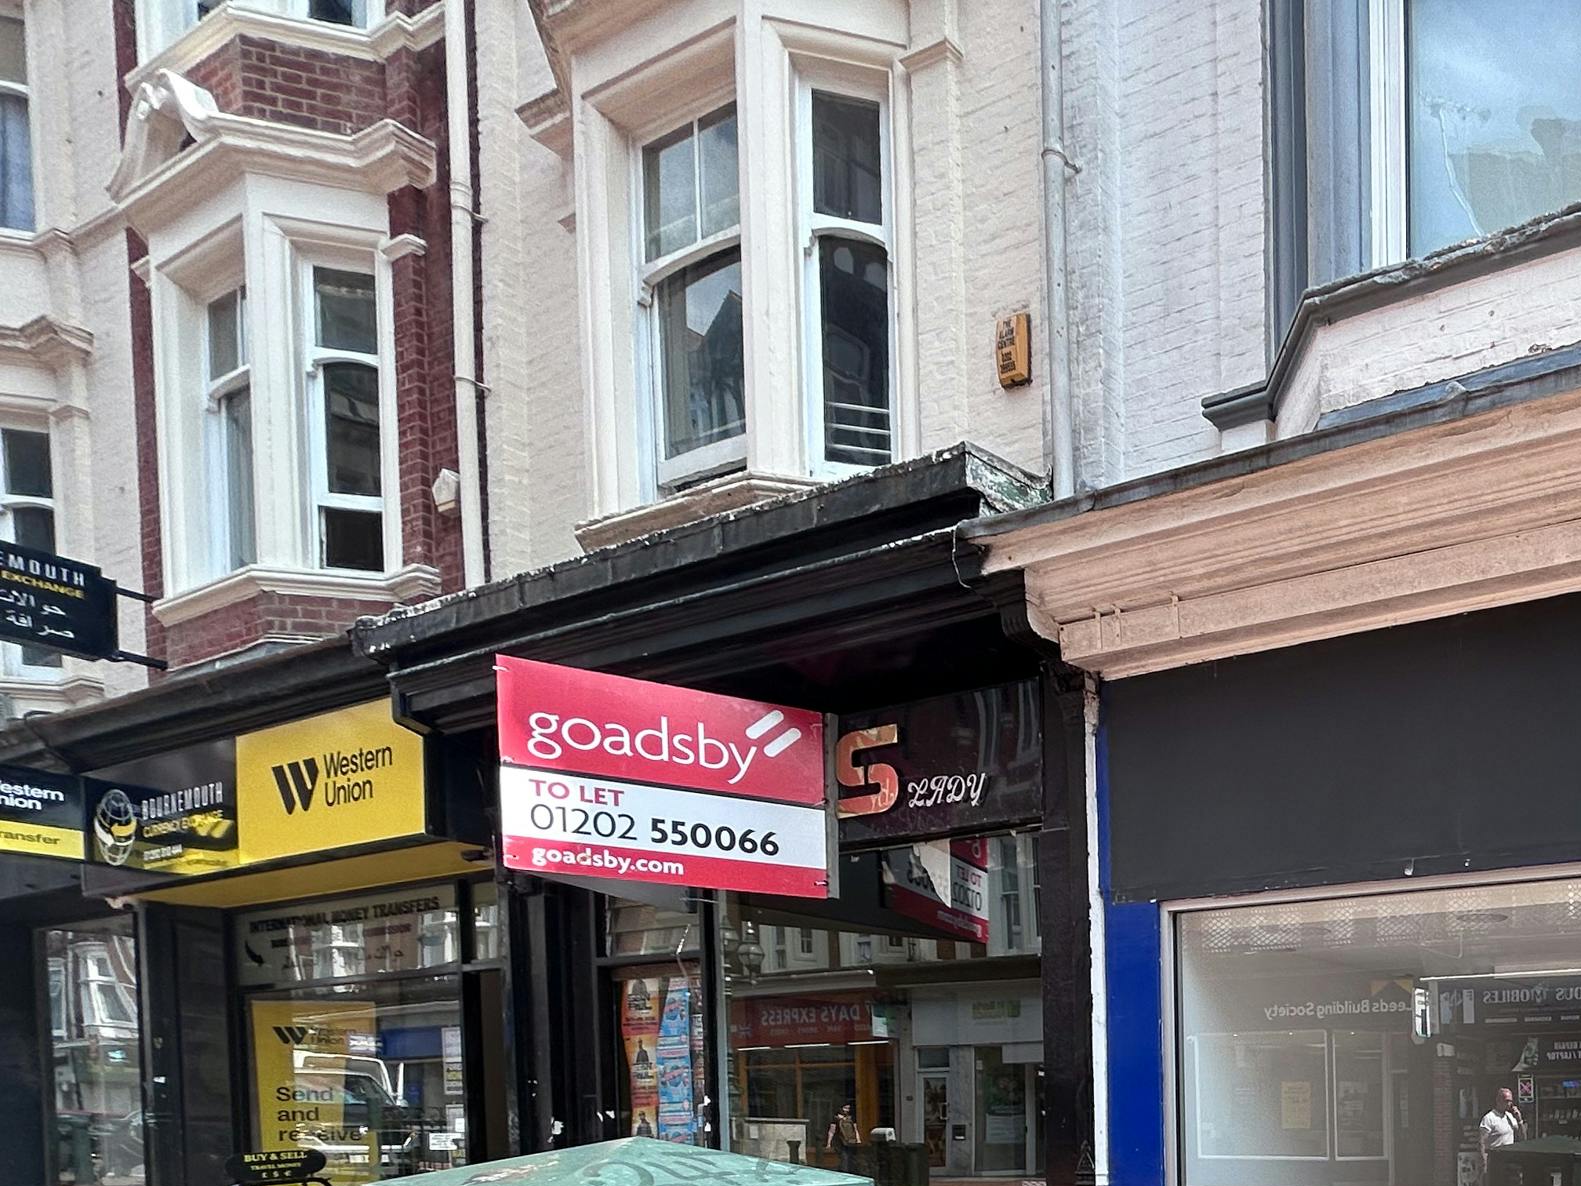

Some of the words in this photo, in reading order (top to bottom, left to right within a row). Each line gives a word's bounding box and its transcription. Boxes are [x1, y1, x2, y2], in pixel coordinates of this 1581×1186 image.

[1, 569, 85, 600] EXCHANGE
[323, 745, 393, 779] Western
[527, 711, 757, 785] goadsby
[0, 782, 65, 802] estern
[142, 781, 223, 821] BOURNEMOUTH
[324, 777, 374, 807] Union
[528, 778, 570, 798] TO
[579, 785, 624, 807] LET
[907, 772, 986, 808] LADY
[530, 803, 638, 841] 01202
[651, 817, 780, 857] 550066
[531, 847, 685, 876] goadsby.com
[372, 896, 441, 918] TRANSFERS
[276, 1086, 334, 1102] Send
[277, 1107, 320, 1122] and
[244, 1154, 268, 1163] BUY
[269, 1153, 278, 1161] &
[280, 1151, 307, 1160] SELL
